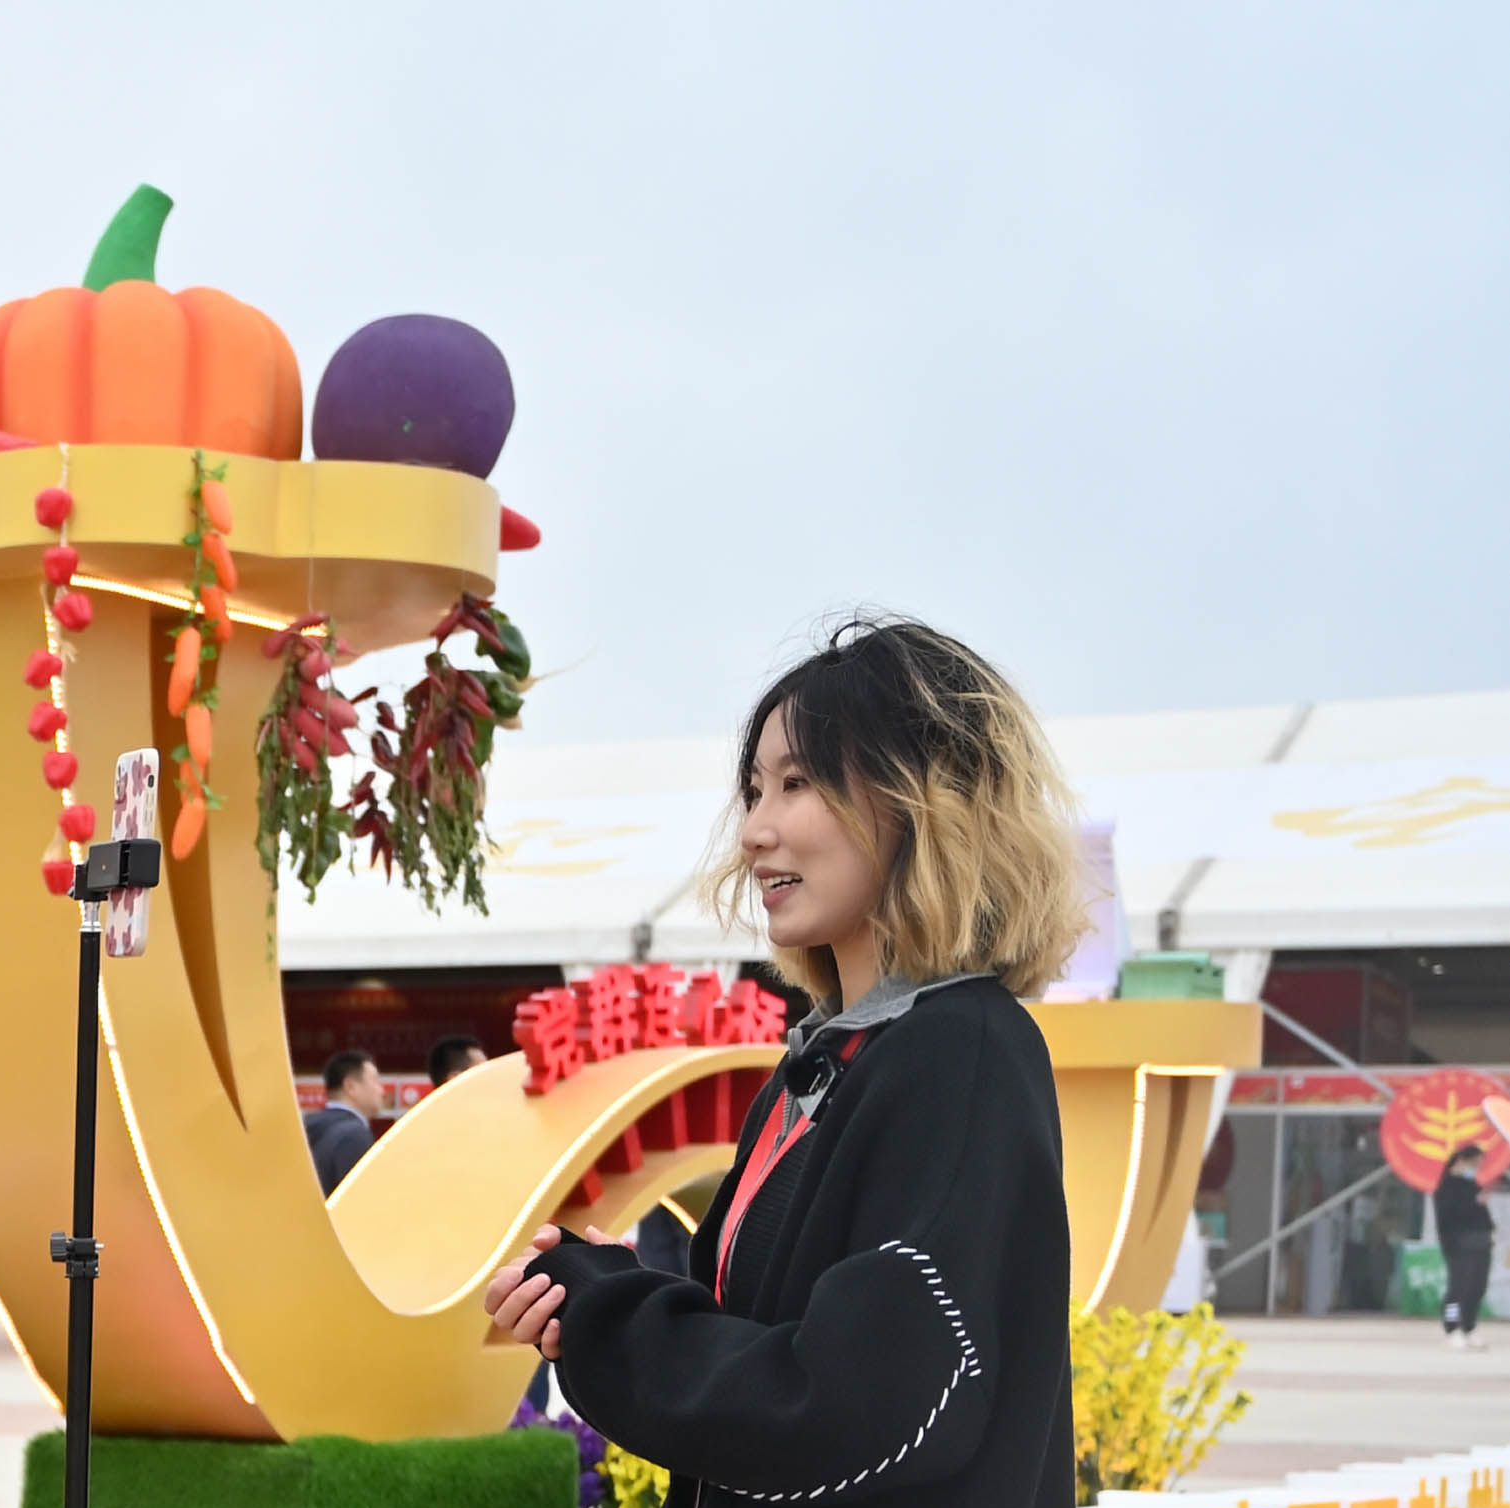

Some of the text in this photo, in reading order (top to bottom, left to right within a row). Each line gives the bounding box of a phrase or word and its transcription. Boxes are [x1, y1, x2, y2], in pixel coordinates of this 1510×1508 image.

[513, 962, 787, 1096] 党群连心桥
